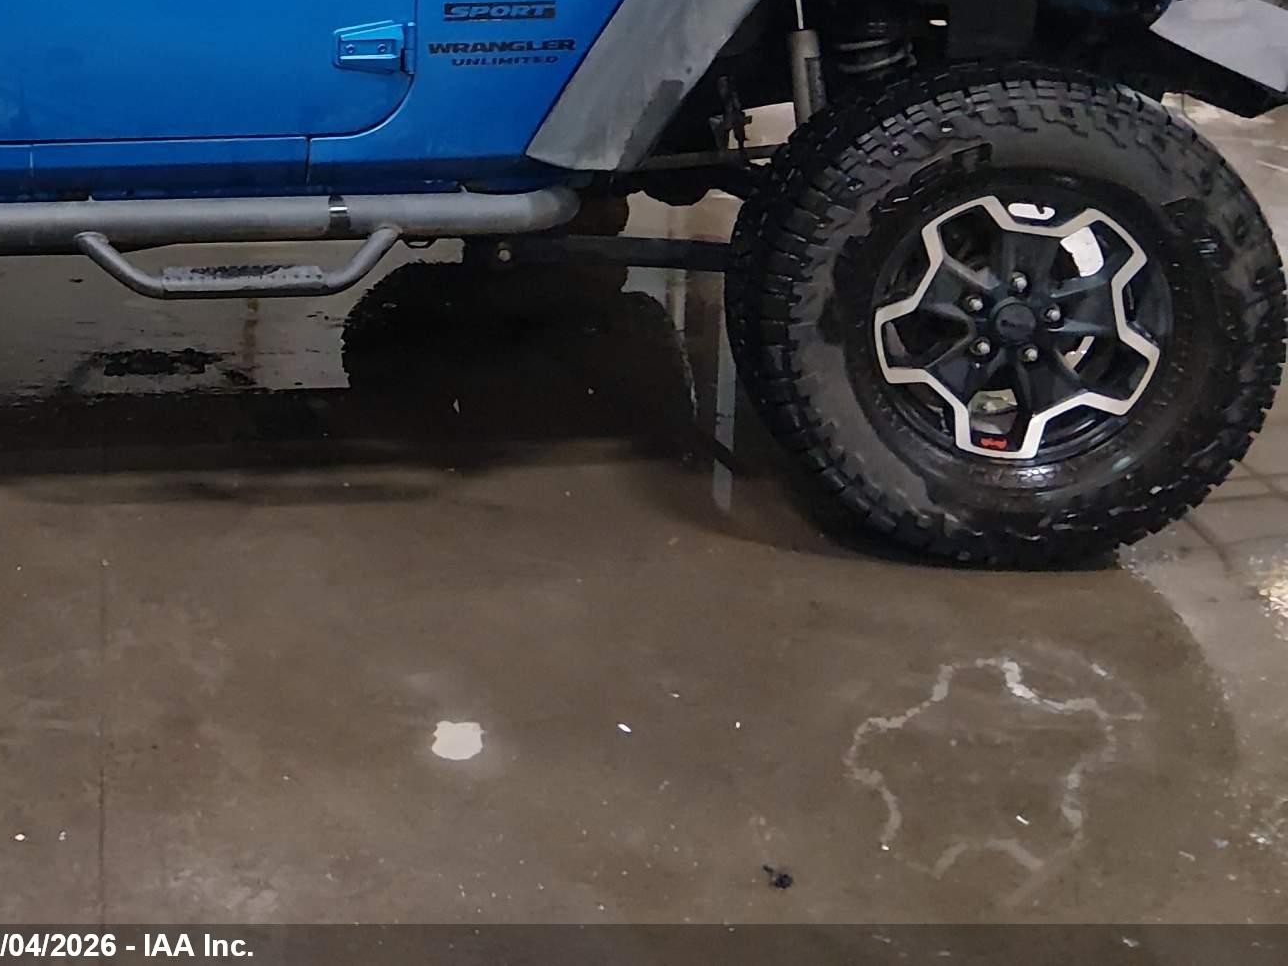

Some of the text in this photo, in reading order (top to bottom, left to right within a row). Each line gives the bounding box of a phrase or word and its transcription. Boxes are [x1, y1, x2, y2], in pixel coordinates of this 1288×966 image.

[445, 3, 556, 19] SPORT
[429, 39, 576, 53] WRANGLER
[452, 56, 559, 66] UNLIMITED
